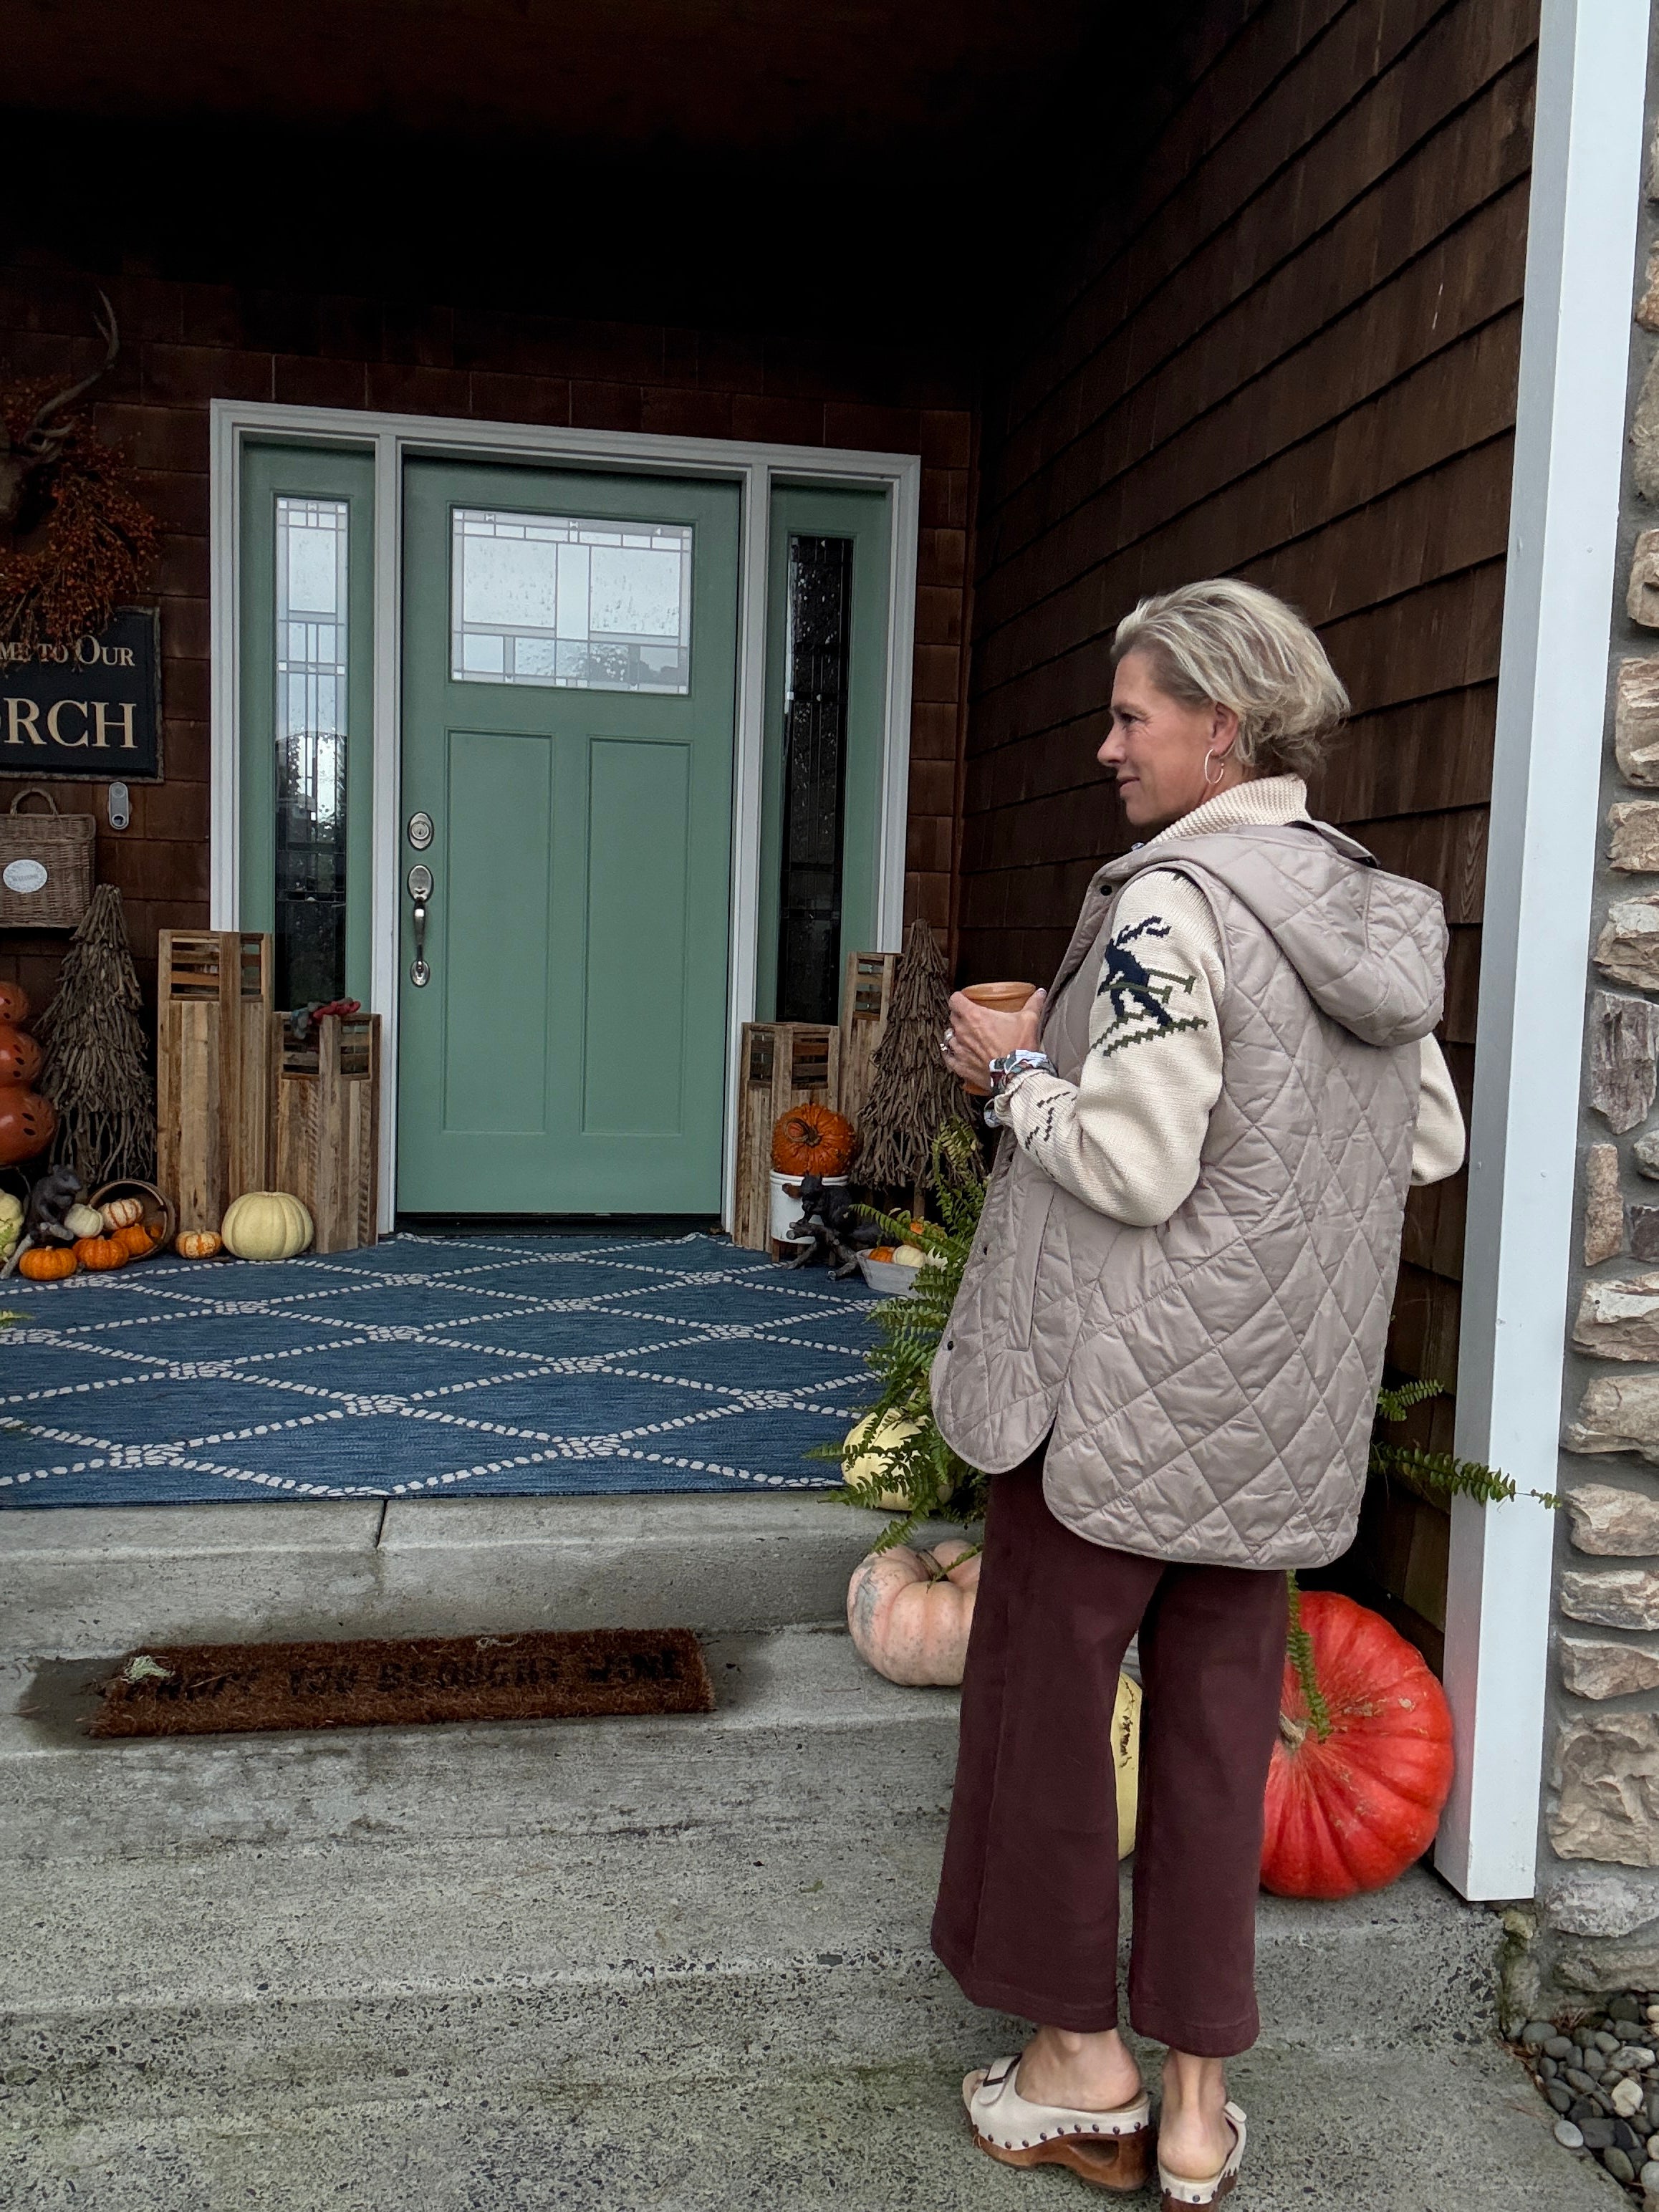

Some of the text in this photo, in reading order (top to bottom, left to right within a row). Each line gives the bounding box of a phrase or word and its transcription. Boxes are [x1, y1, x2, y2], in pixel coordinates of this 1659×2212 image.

[37, 643, 69, 663] TO
[75, 635, 135, 666] OUR
[0, 698, 138, 748] RCH
